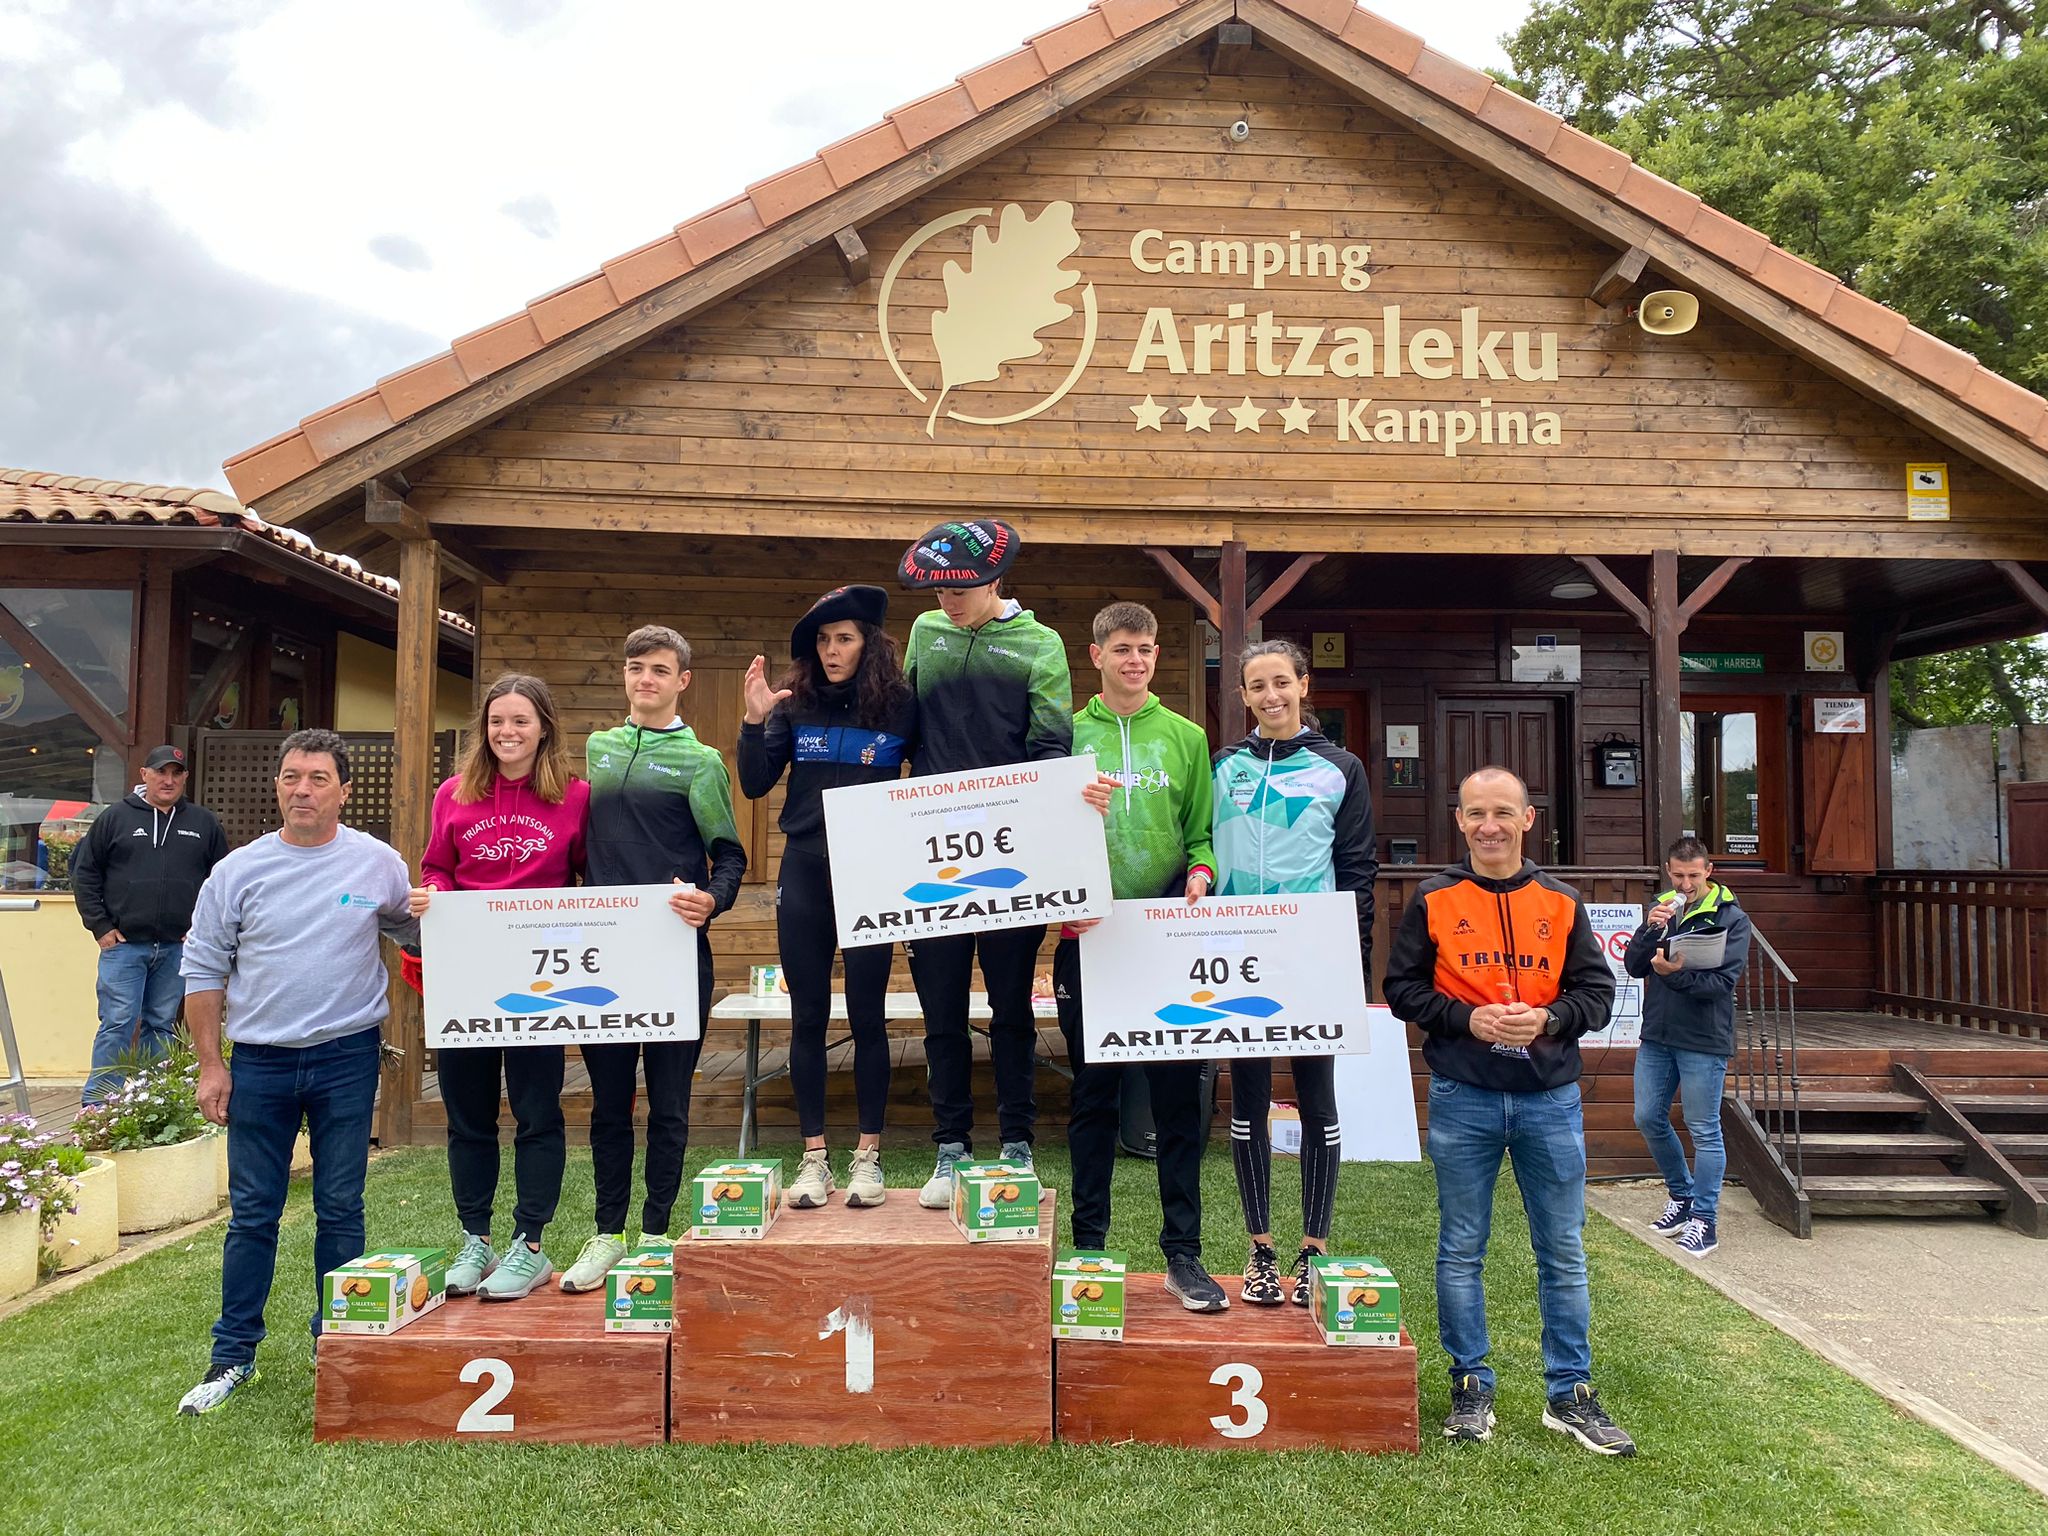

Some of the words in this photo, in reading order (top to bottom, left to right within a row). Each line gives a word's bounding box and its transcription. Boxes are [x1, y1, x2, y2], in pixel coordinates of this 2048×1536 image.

[1130, 229, 1371, 292] Camping
[1127, 304, 1558, 381] Aritzaleku
[1337, 397, 1562, 456] Kanpina
[1724, 658, 1762, 668] HARRERA
[888, 782, 954, 802] TRIATLON
[958, 771, 1039, 794] ARITZALEKU
[918, 806, 952, 817] CLASIFICADO
[953, 802, 985, 812] CATEGORÍA
[986, 798, 1018, 808] MASCULINA
[462, 815, 507, 842] TRIATLON
[510, 814, 555, 840] ANTSOAIN
[926, 830, 984, 864] 150
[994, 826, 1014, 854] €
[486, 899, 554, 912] TRIATLON
[557, 896, 639, 910] ARITZALEKU
[851, 888, 1088, 932] ARITZALEKU
[1144, 906, 1212, 920] TRIATLON
[1216, 904, 1298, 918] ARITZALEKU
[1590, 910, 1633, 918] PISCINA
[852, 924, 950, 942] TRIATLON
[982, 907, 1090, 926] TRIATLOIA
[532, 948, 570, 975] 75
[580, 947, 600, 974] €
[1189, 957, 1229, 985] 40
[1240, 956, 1260, 984] €
[1458, 951, 1550, 970] TRIKUA
[1461, 968, 1549, 978] TRIALON
[440, 1012, 674, 1034] ARITZALEKU
[440, 1035, 536, 1043] TRIATLON
[570, 1030, 676, 1039] TRIATLOIA
[1099, 1024, 1343, 1048] ARITZALEKU
[1099, 1048, 1200, 1058] TRIATLON
[1236, 1044, 1346, 1052] TRIATLOIA
[456, 1358, 514, 1432] 2
[1208, 1362, 1269, 1439] 3
